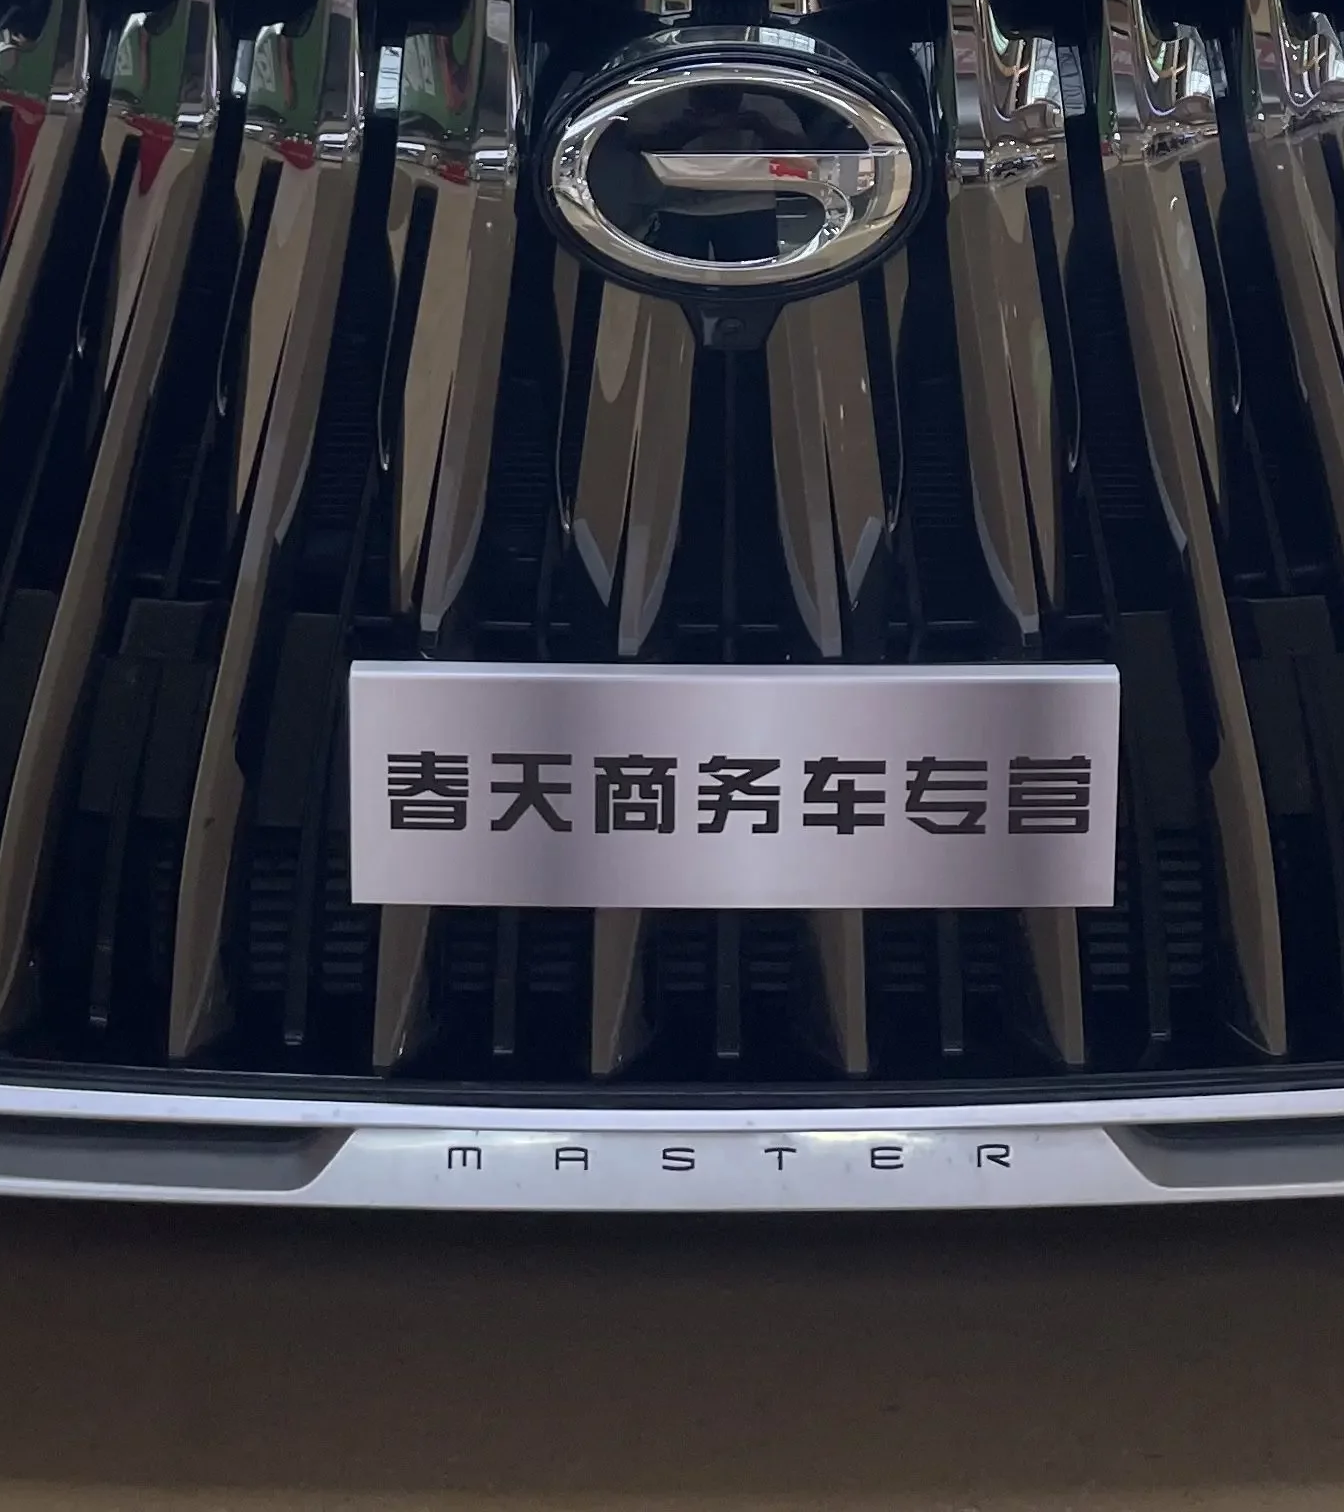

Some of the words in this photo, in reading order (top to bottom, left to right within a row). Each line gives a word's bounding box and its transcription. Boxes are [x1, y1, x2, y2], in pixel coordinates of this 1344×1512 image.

[386, 750, 1092, 836] 春天商务车专营
[446, 1143, 1013, 1172] MASTER
